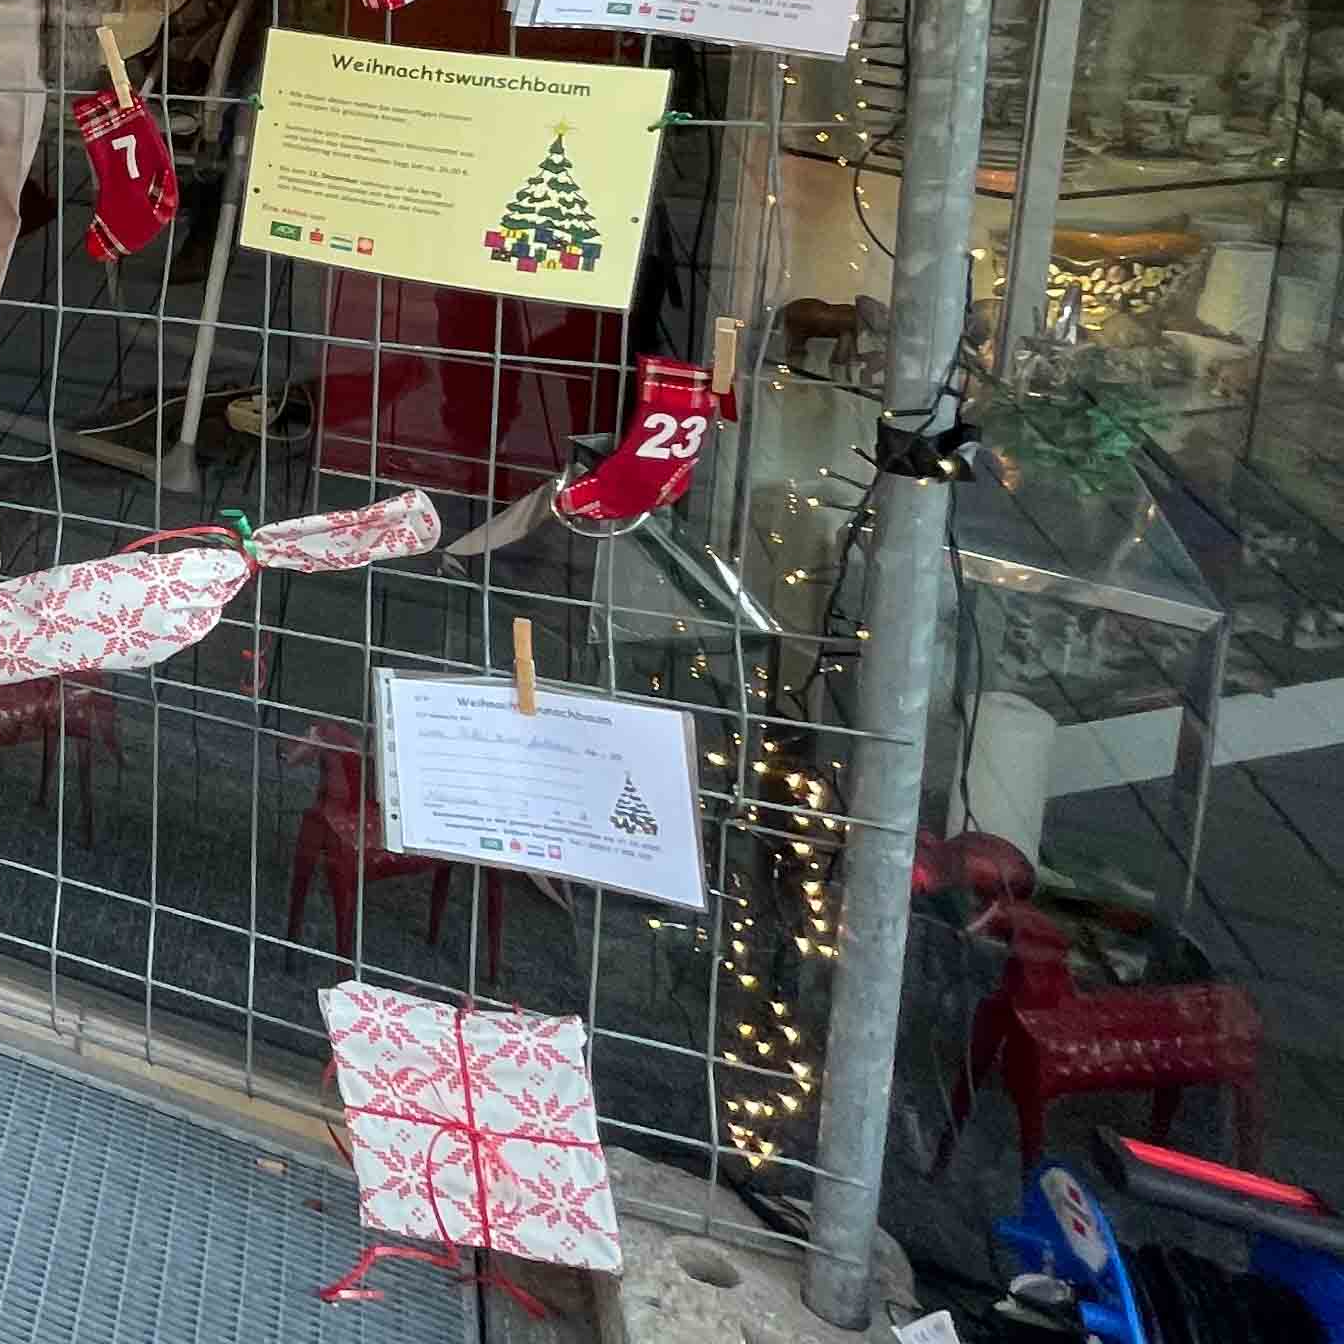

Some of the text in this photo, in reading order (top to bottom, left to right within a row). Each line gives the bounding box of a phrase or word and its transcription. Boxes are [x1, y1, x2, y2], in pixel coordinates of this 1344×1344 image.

[332, 53, 591, 97] Weihnachtswunschbaum
[112, 134, 140, 180] 7
[635, 413, 708, 460] 23
